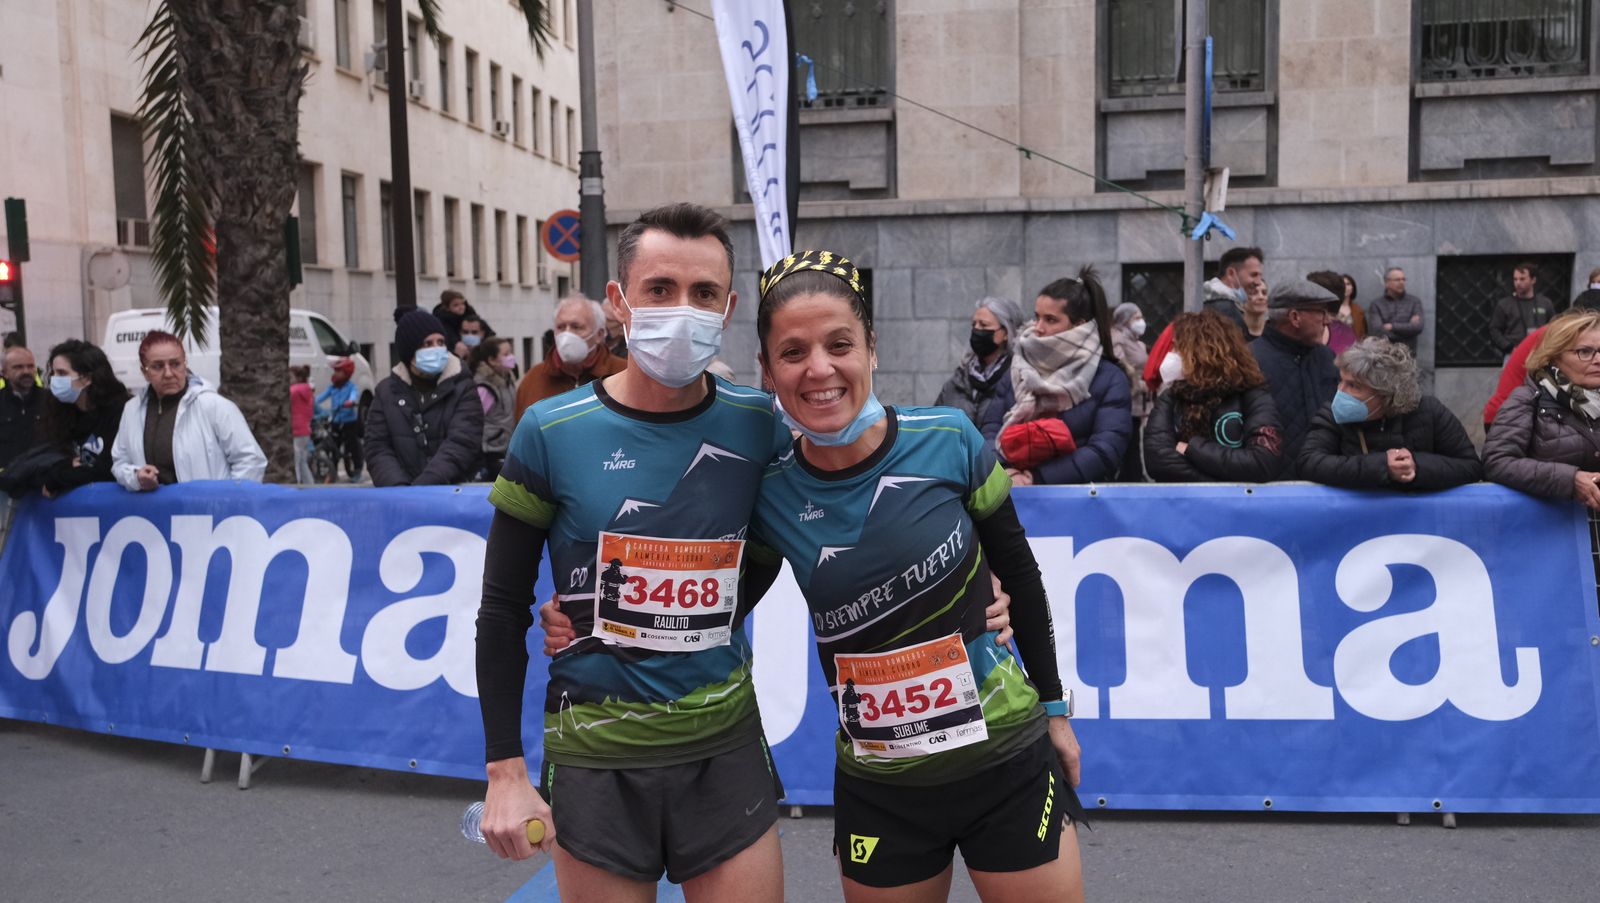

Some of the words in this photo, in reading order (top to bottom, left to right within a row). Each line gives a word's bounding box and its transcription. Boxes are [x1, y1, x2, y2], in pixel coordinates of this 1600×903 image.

[602, 460, 636, 471] TMRG
[798, 509, 825, 522] TMRG
[825, 575, 898, 630] SIEMPRE
[900, 519, 964, 590] FUERTE
[623, 575, 720, 609] 3468
[653, 616, 690, 630] RAULITO
[647, 633, 678, 641] COSENTINO
[684, 634, 701, 643] CASI
[859, 677, 958, 722] 3452
[892, 720, 930, 739] SUBLIME
[929, 734, 948, 745] CASI
[1037, 770, 1056, 842] SCOTT
